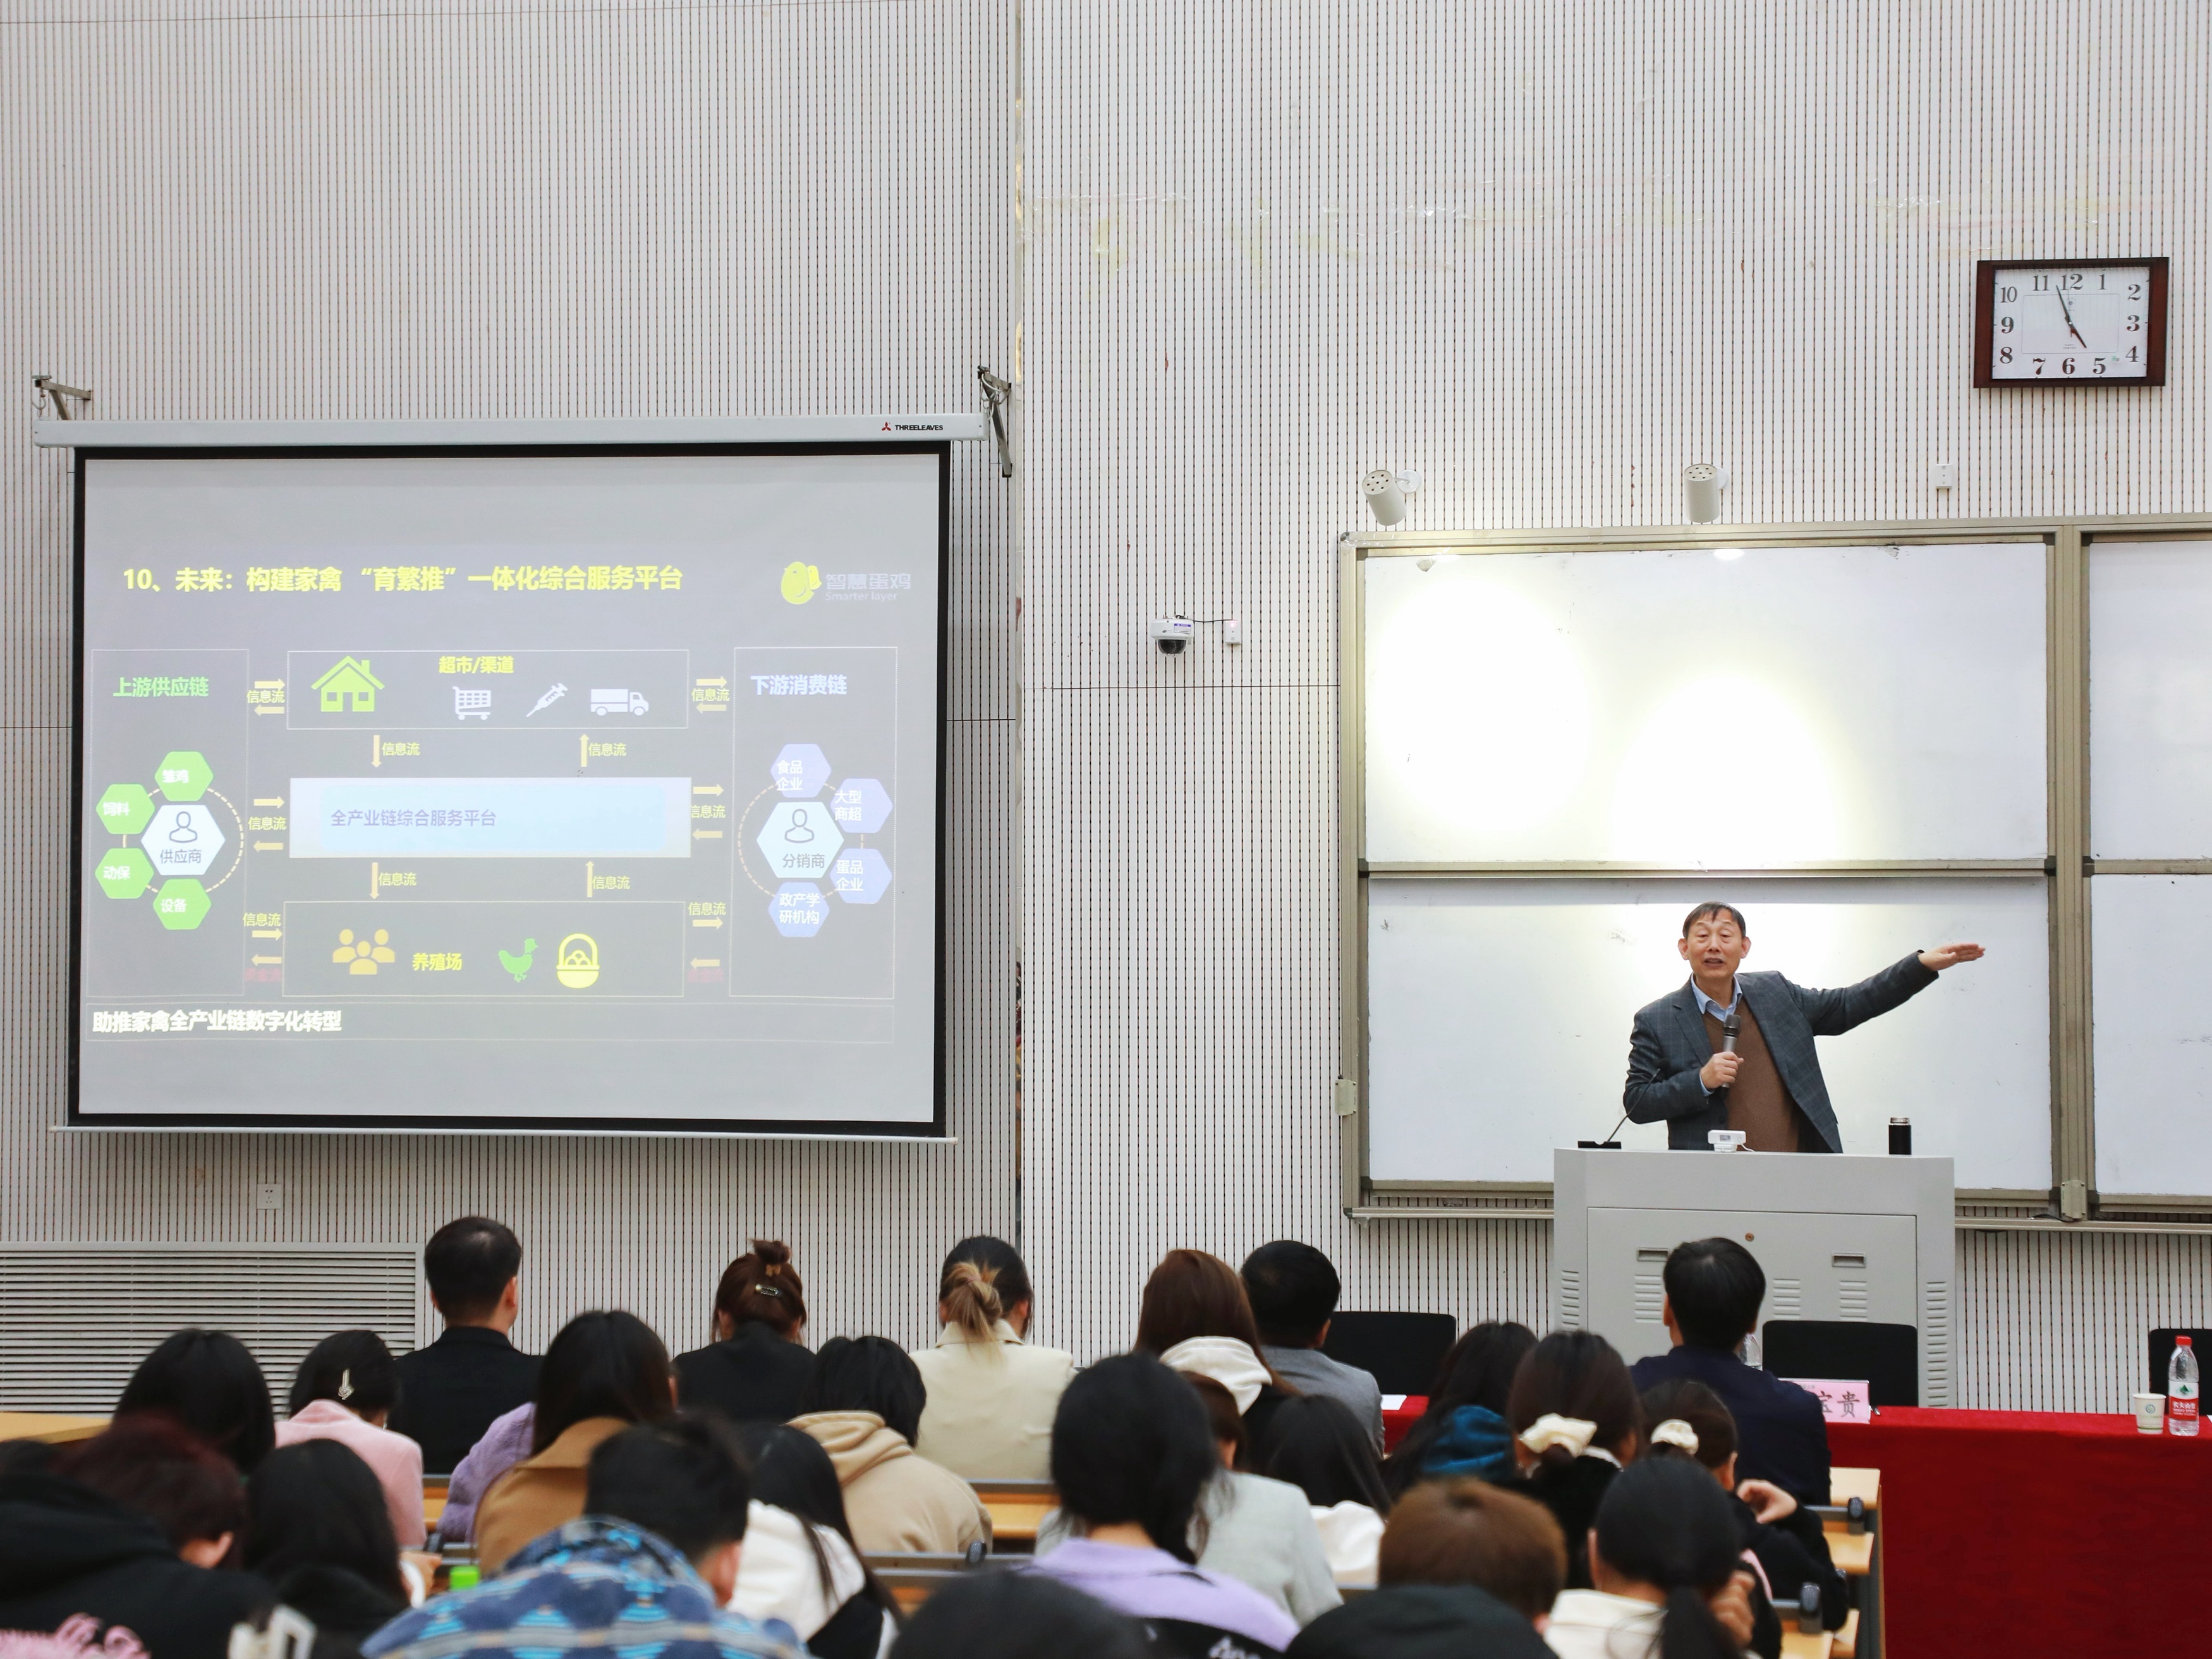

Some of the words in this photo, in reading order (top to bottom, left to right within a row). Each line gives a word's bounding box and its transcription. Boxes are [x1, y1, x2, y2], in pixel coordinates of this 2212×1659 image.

[2033, 274, 2049, 291] 11
[2060, 273, 2083, 291] 12
[2098, 274, 2107, 290] 1
[2000, 286, 2018, 303] 10
[2127, 284, 2141, 301] 2
[2000, 316, 2014, 334] 9
[2126, 315, 2140, 332] 3
[2000, 346, 2014, 364] 8
[2125, 345, 2139, 363] 4
[2033, 358, 2046, 375] 7
[2062, 357, 2075, 375] 6
[2092, 357, 2106, 375] 5
[825, 573, 911, 590] 智慧蛋鸡
[825, 590, 870, 601] Smarter
[871, 591, 898, 602] layer
[439, 656, 514, 674] 超市/渠道
[112, 677, 210, 698] 上游供应链
[750, 674, 848, 696] 下游消费链
[246, 690, 285, 703] 信息流
[691, 688, 729, 702] 信息流
[381, 742, 420, 757] 信息流
[588, 743, 627, 758] 信息流
[775, 760, 803, 775] 食品
[775, 776, 803, 792] 企业
[834, 789, 862, 805] 大型
[331, 810, 497, 827] 全产业链综合服务平台
[834, 806, 862, 822] 商超
[248, 816, 286, 831] 信息流
[159, 848, 202, 865] 供应商
[782, 853, 825, 869] 分销商
[102, 866, 130, 880] 动保
[836, 860, 863, 875] 蛋品
[378, 872, 417, 887] 信息流
[591, 876, 630, 891] 信息流
[836, 876, 863, 892] 企业
[160, 899, 188, 914] 设备
[779, 892, 820, 908] 政产学
[688, 902, 726, 916] 信息流
[779, 909, 820, 925] 研机构
[242, 912, 281, 927] 信息流
[412, 952, 463, 972] 养殖场
[92, 1010, 343, 1033] 助推家禽全产业链数字化转型
